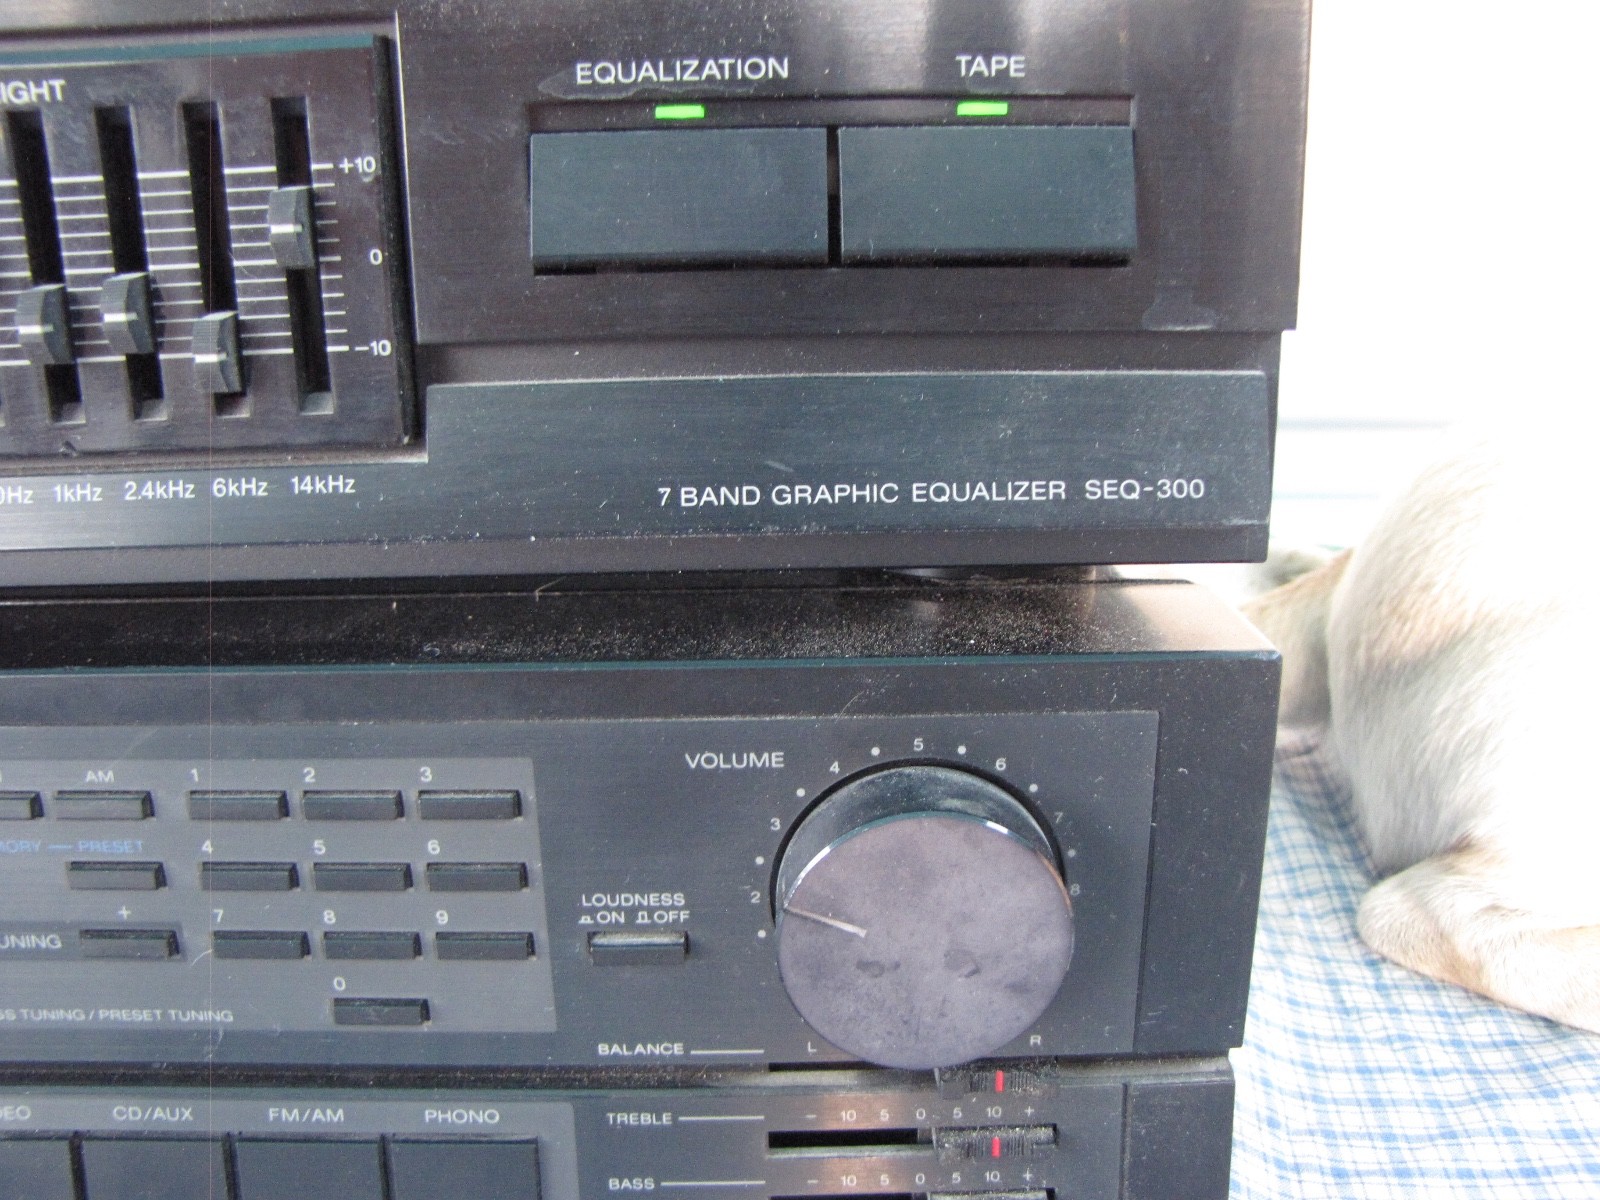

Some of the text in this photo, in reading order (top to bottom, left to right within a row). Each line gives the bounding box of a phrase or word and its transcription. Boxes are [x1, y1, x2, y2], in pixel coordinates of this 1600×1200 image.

[575, 57, 789, 85] EQUALIZATION
[956, 54, 1026, 79] TAPE
[338, 156, 376, 176] +10
[369, 248, 383, 266] 0
[53, 483, 103, 503] 1kHz
[124, 479, 196, 501] 2.4kHz
[211, 476, 269, 498] 6kHz
[290, 474, 356, 496] 14kHz
[657, 477, 1206, 508] 7 BAND GRAPHIC EQUALIZER SEQ-300
[912, 737, 925, 753] 5
[684, 751, 785, 770] VOLUME
[829, 760, 841, 775] 4
[995, 757, 1007, 772] 6
[85, 769, 115, 784] AM
[189, 767, 200, 783] 1
[303, 766, 317, 784] 2
[419, 765, 434, 783] 3
[769, 816, 782, 832] 3
[1054, 811, 1064, 824] 7
[0, 839, 144, 854] ORY PRESET
[201, 839, 214, 855] 4
[313, 838, 328, 856] 5
[427, 838, 442, 855] 6
[749, 891, 762, 904] 2
[1070, 883, 1081, 897] 8
[581, 893, 687, 908] LOUDNESS
[212, 908, 225, 924] 7
[322, 909, 337, 926] 8
[434, 908, 450, 926] 9
[596, 910, 691, 925] ON OFF
[332, 976, 347, 992] 0
[20, 1008, 86, 1022] TUNING
[99, 1008, 163, 1023] PRESET
[168, 1008, 234, 1023] TUNING
[806, 1041, 817, 1053] L
[1029, 1034, 1042, 1047] R
[597, 1042, 685, 1057] BALANCE
[0, 1105, 32, 1121] EO
[112, 1105, 194, 1122] CD/AUX
[268, 1106, 345, 1123] FM/AM
[424, 1107, 500, 1125] PHONO
[606, 1112, 672, 1126] TREBLE
[840, 1110, 857, 1122] 10
[879, 1109, 890, 1122] 5
[915, 1108, 927, 1120] 0
[952, 1106, 963, 1119] 5
[985, 1105, 1002, 1117] 10
[608, 1177, 656, 1192] BASS
[840, 1174, 857, 1187] 10
[879, 1174, 890, 1186] 5
[915, 1173, 926, 1185] 0
[951, 1172, 962, 1184] 5
[984, 1170, 1000, 1182] 10
